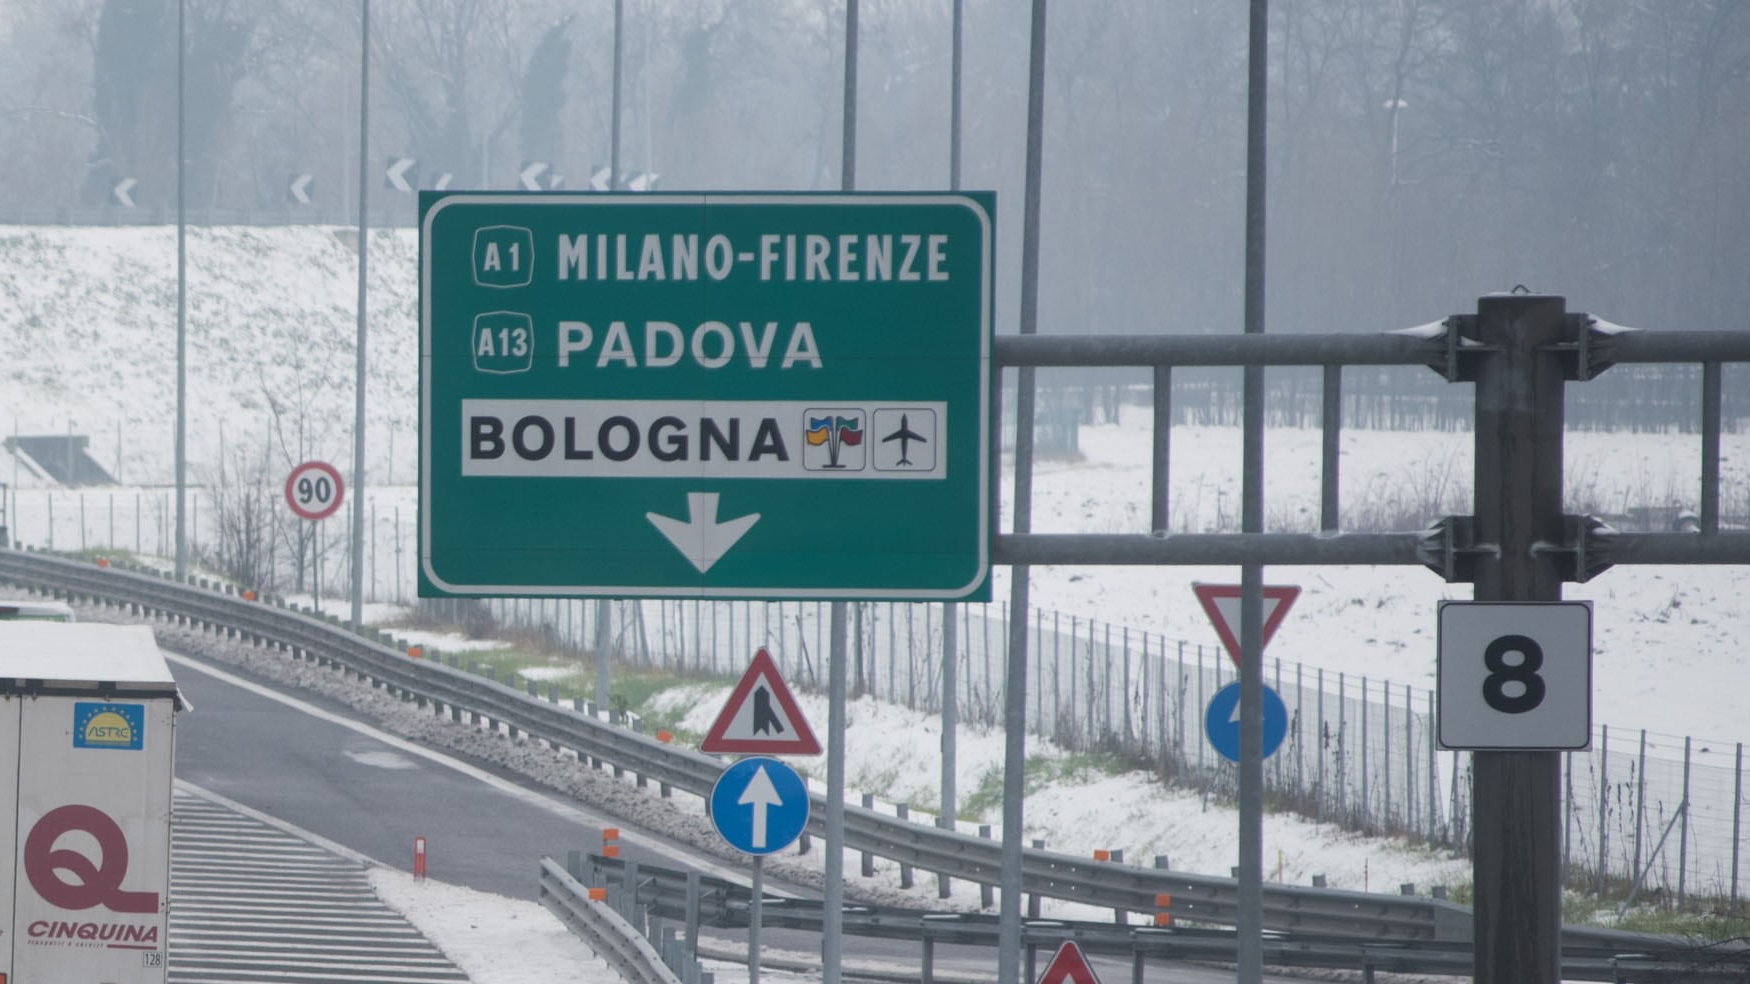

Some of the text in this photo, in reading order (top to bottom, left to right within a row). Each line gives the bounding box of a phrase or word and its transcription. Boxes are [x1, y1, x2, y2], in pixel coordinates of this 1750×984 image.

[558, 233, 950, 282] MILANO-FIRENZE
[477, 321, 824, 370] A13 PADOVA
[470, 415, 791, 463] BOLOGNA
[298, 477, 331, 504] 90
[1482, 634, 1546, 714] 8
[27, 920, 158, 942] CINQUINA
[145, 953, 161, 966] 128
